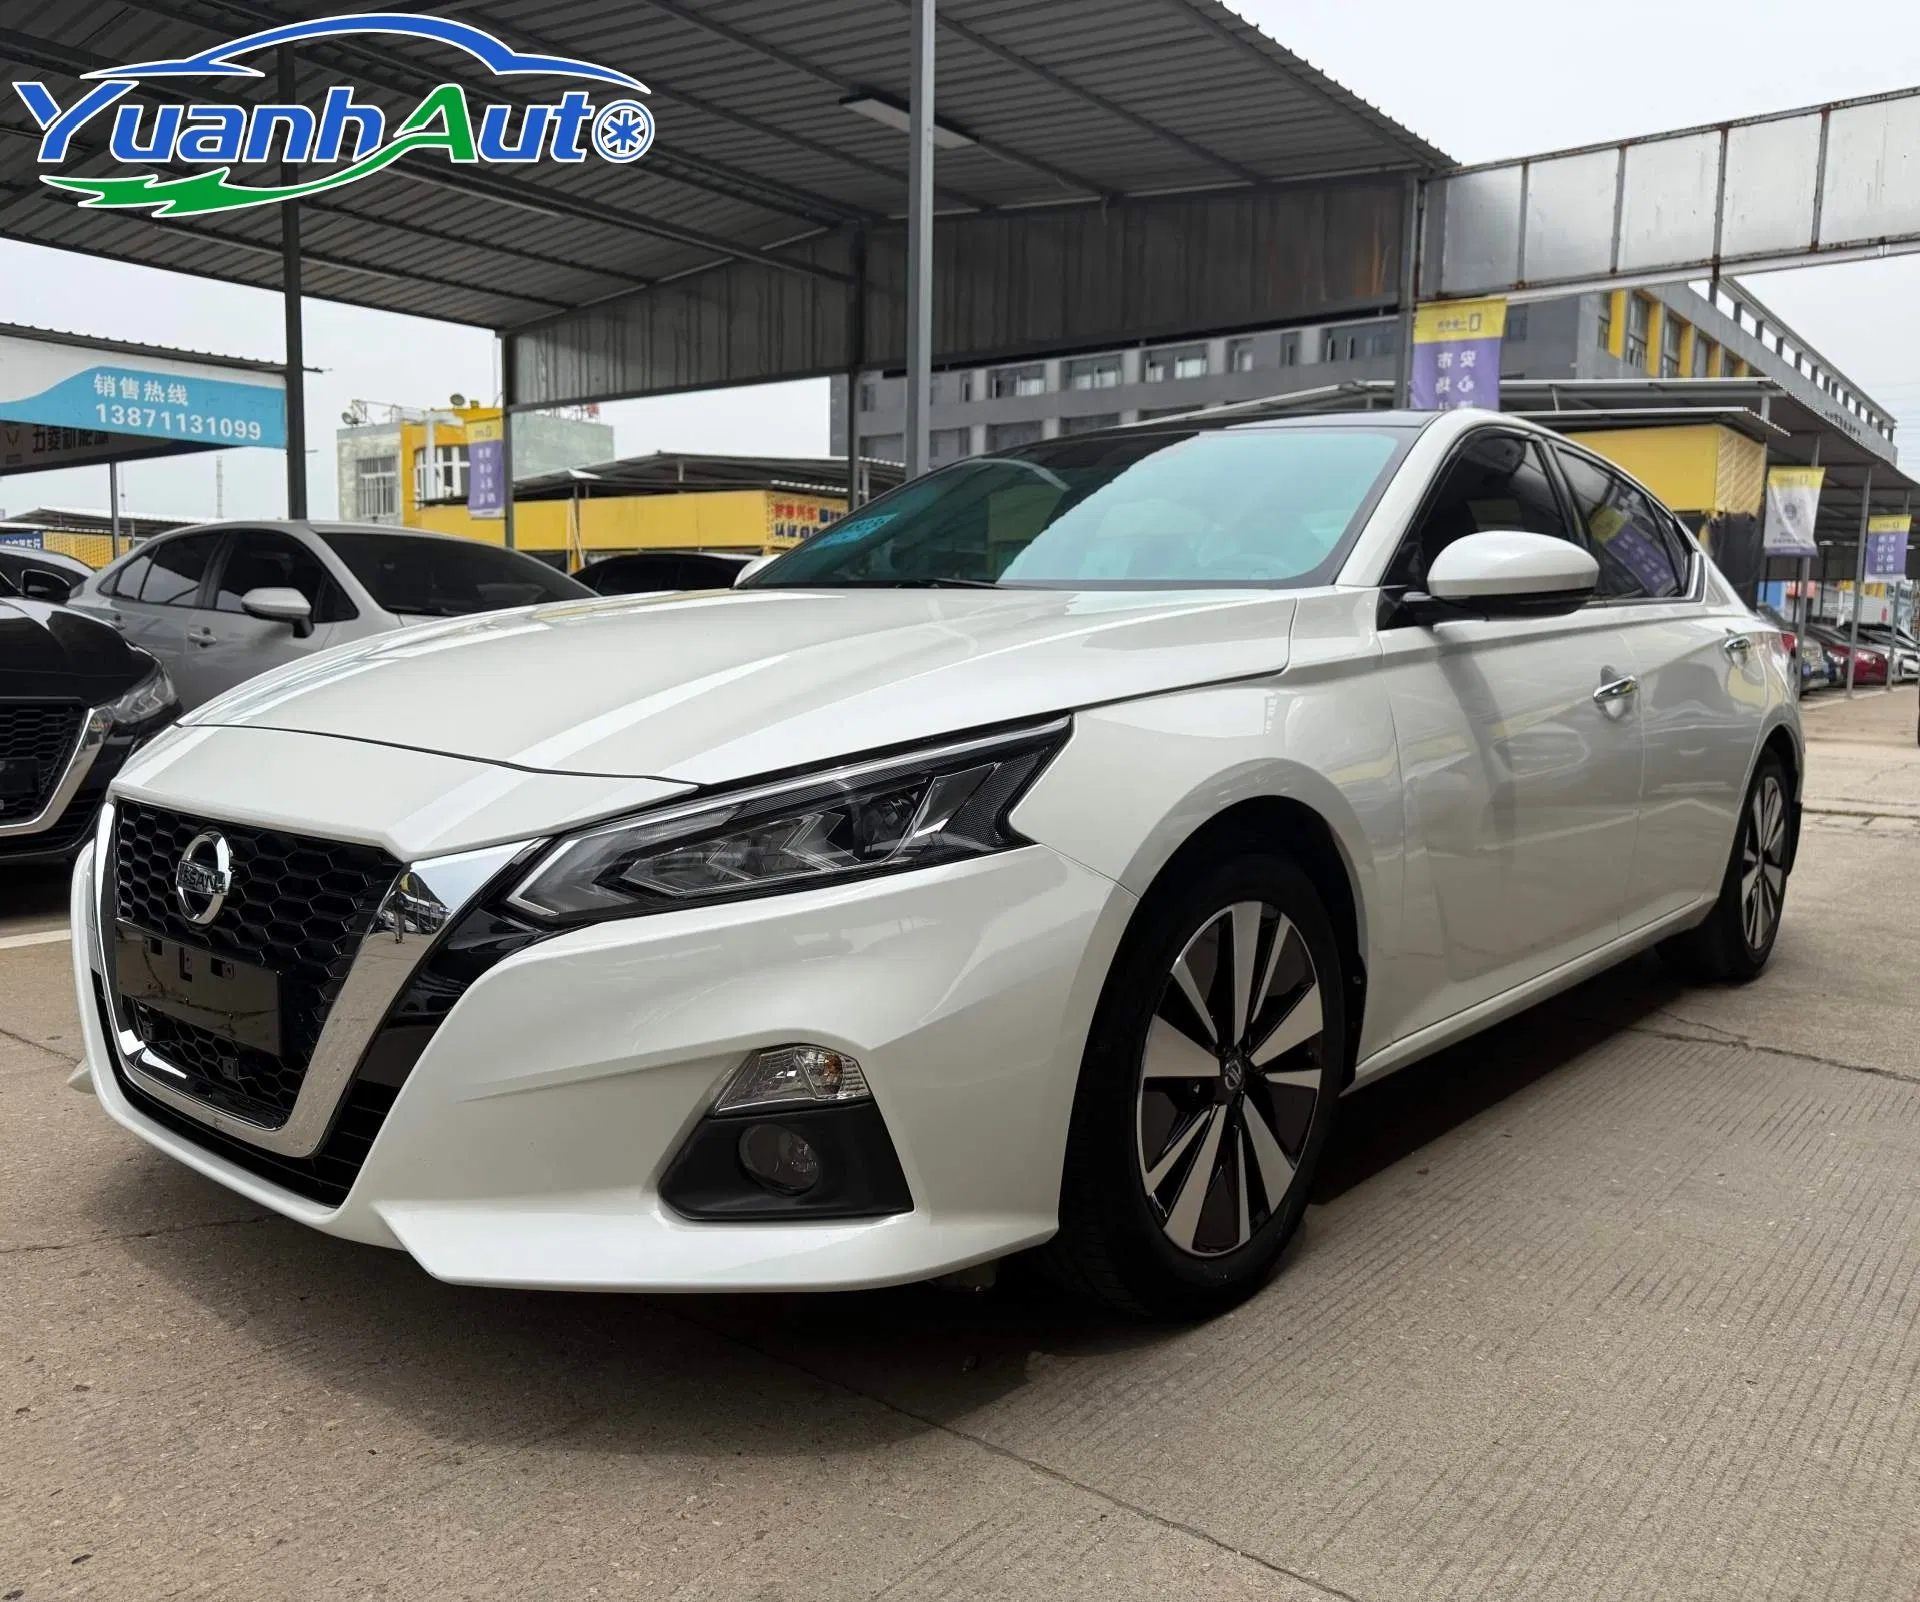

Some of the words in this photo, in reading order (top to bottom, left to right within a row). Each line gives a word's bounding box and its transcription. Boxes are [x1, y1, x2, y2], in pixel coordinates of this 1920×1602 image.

[94, 373, 189, 406] 销售热线
[95, 403, 262, 441] 13871131099
